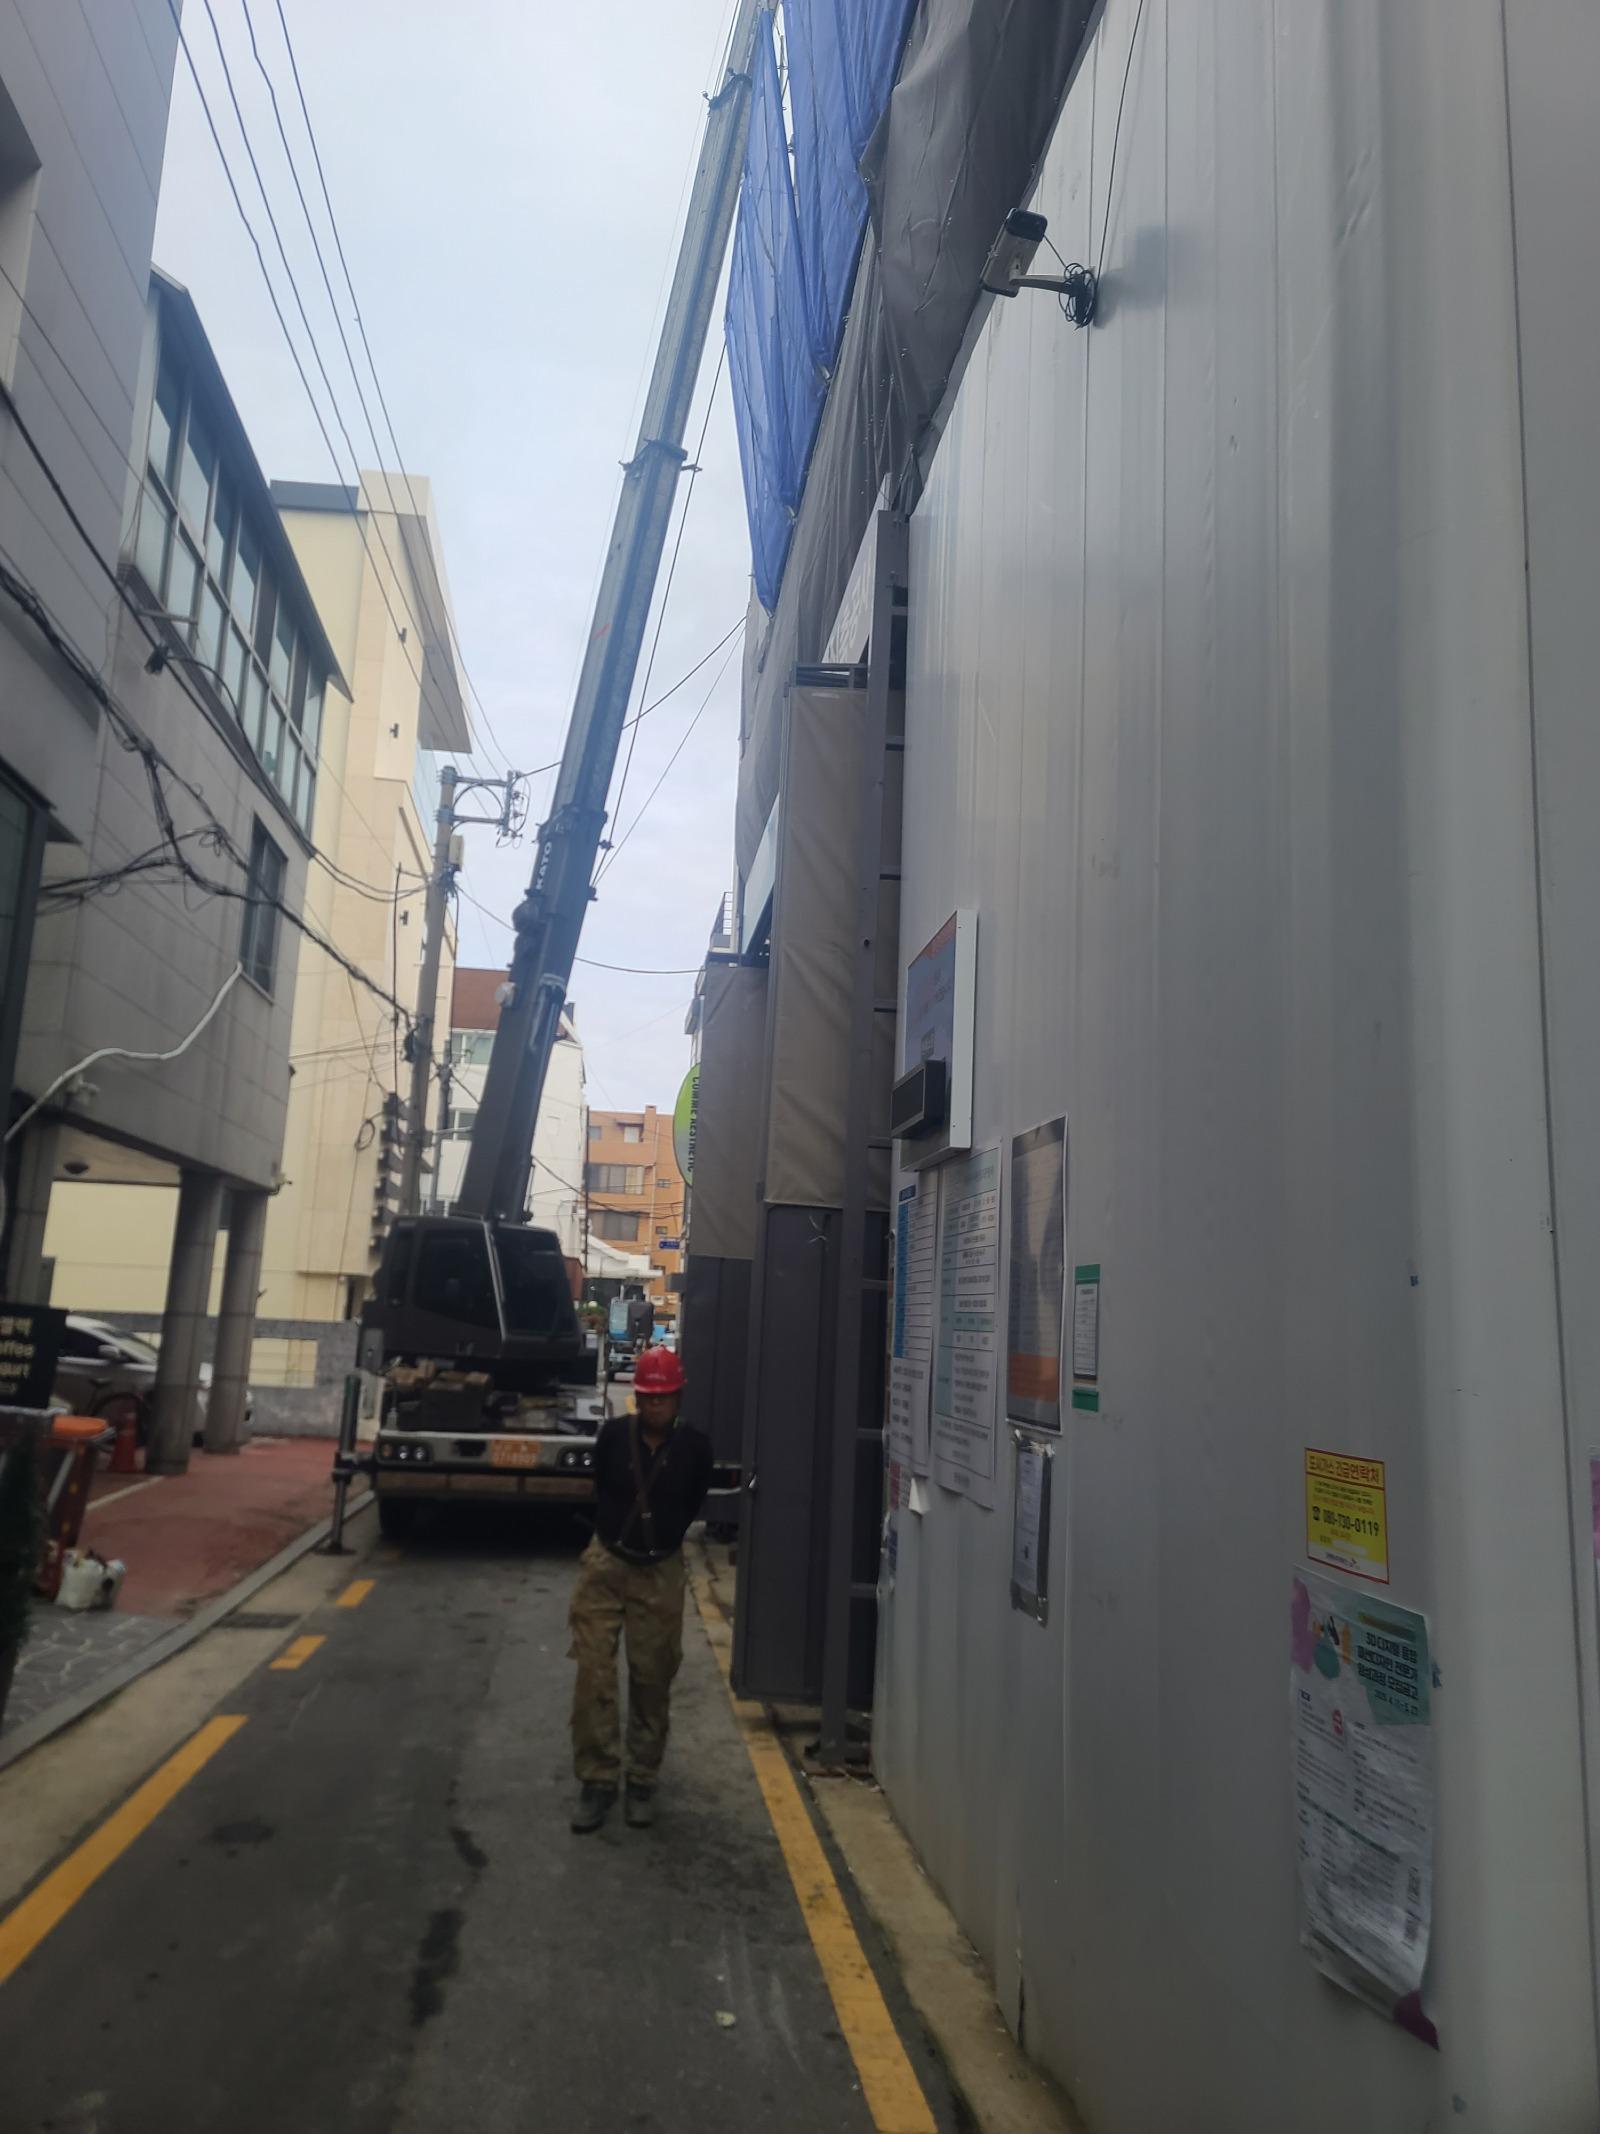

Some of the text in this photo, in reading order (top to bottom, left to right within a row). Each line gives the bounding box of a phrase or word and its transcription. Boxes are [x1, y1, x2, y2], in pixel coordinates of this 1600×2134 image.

[536, 841, 552, 890] KATO
[1308, 1455, 1380, 1483] 도시가스 긴급연락처
